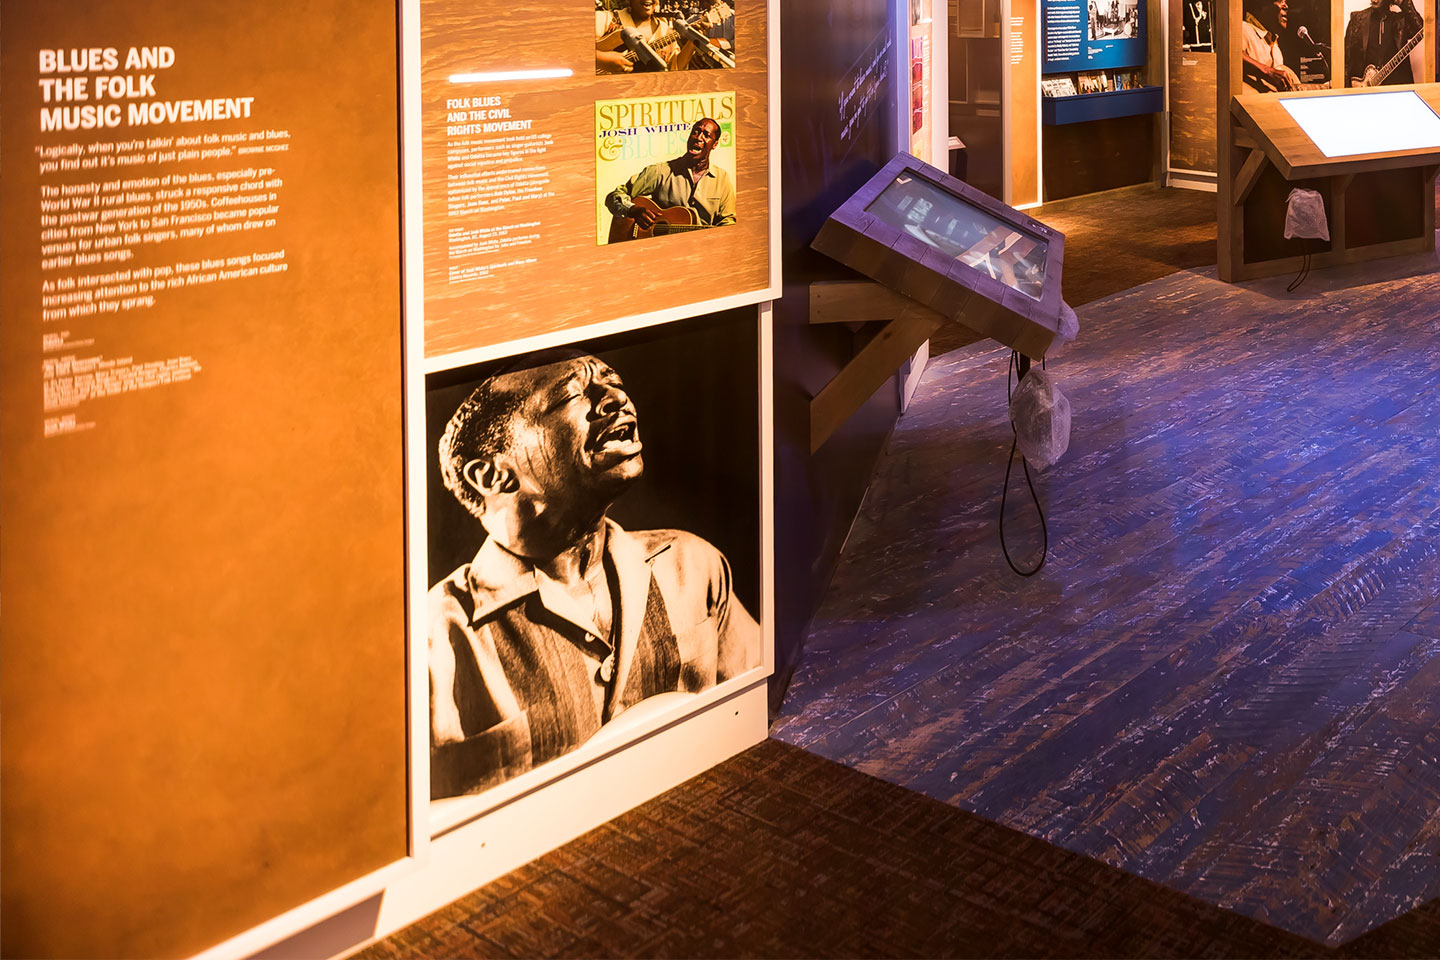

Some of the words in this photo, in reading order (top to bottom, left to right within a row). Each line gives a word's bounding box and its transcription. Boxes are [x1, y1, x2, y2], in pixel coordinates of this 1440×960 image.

[39, 49, 118, 73] BLUES
[125, 47, 175, 70] AND
[39, 78, 88, 102] THE
[95, 75, 155, 100] FOLK
[40, 105, 121, 132] MUSIC
[128, 98, 254, 126] MOVEMENT
[447, 99, 470, 109] FOLK
[472, 97, 501, 107] BLUES
[599, 96, 733, 131] SPIRITUALS
[447, 112, 467, 122] AND
[469, 110, 486, 121] THE
[488, 109, 512, 119] CIVIL
[447, 124, 481, 136] RIGHTS
[483, 120, 532, 133] MOVEMENT
[599, 128, 637, 138] JOSH
[646, 123, 692, 133] WHITE
[88, 142, 114, 153] when
[176, 136, 201, 147] about
[203, 134, 220, 144] folk
[221, 133, 247, 143] music
[248, 130, 265, 141] and
[598, 136, 626, 161] &
[40, 162, 58, 174] you
[60, 158, 80, 170] find
[82, 157, 98, 168] out
[117, 154, 145, 165] music
[147, 152, 157, 163] of
[158, 151, 176, 164] just
[177, 150, 200, 162] plain
[41, 199, 70, 212] World
[72, 197, 91, 209] War
[101, 193, 124, 206] rural
[155, 188, 184, 200] struck
[185, 188, 192, 198] a
[192, 184, 239, 196] responsive
[240, 180, 264, 191] chord
[265, 178, 283, 189] with
[42, 186, 60, 198] The
[61, 183, 101, 195] honesty
[102, 180, 121, 192] and
[122, 178, 160, 190] emotion
[161, 175, 171, 186] of
[172, 175, 187, 185] the
[41, 215, 58, 226] the
[60, 212, 98, 226] postwar
[101, 206, 151, 222] generation
[152, 203, 162, 214] of
[163, 202, 179, 213] the
[41, 229, 68, 240] cities
[70, 226, 94, 237] from
[95, 223, 116, 234] New
[118, 220, 138, 232] York
[140, 219, 150, 229] to
[152, 217, 169, 228] San
[170, 214, 212, 225] Francisco
[213, 210, 247, 221] became
[248, 205, 279, 218] popular
[42, 242, 77, 255] venues
[78, 239, 92, 250] for
[94, 237, 122, 249] urban
[124, 233, 141, 244] folk
[180, 228, 204, 238] many
[205, 224, 215, 235] of
[216, 223, 242, 233] whom
[243, 220, 264, 230] drew
[264, 219, 276, 228] on
[41, 256, 73, 269] earlier
[75, 253, 102, 265] blues
[42, 280, 55, 292] As
[57, 278, 76, 290] folk
[78, 270, 131, 287] intersected
[132, 267, 153, 280] with
[175, 263, 200, 273] these
[201, 259, 225, 270] blues
[226, 256, 252, 266] songs
[252, 250, 285, 262] focused
[42, 291, 93, 306] increasing
[95, 285, 137, 299] attention
[139, 282, 149, 292] to
[150, 280, 166, 291] the
[167, 276, 185, 288] rich
[186, 273, 217, 285] African
[218, 268, 258, 280] American
[259, 264, 288, 275] culture
[42, 309, 67, 321] from
[69, 303, 97, 317] which
[99, 301, 120, 313] they
